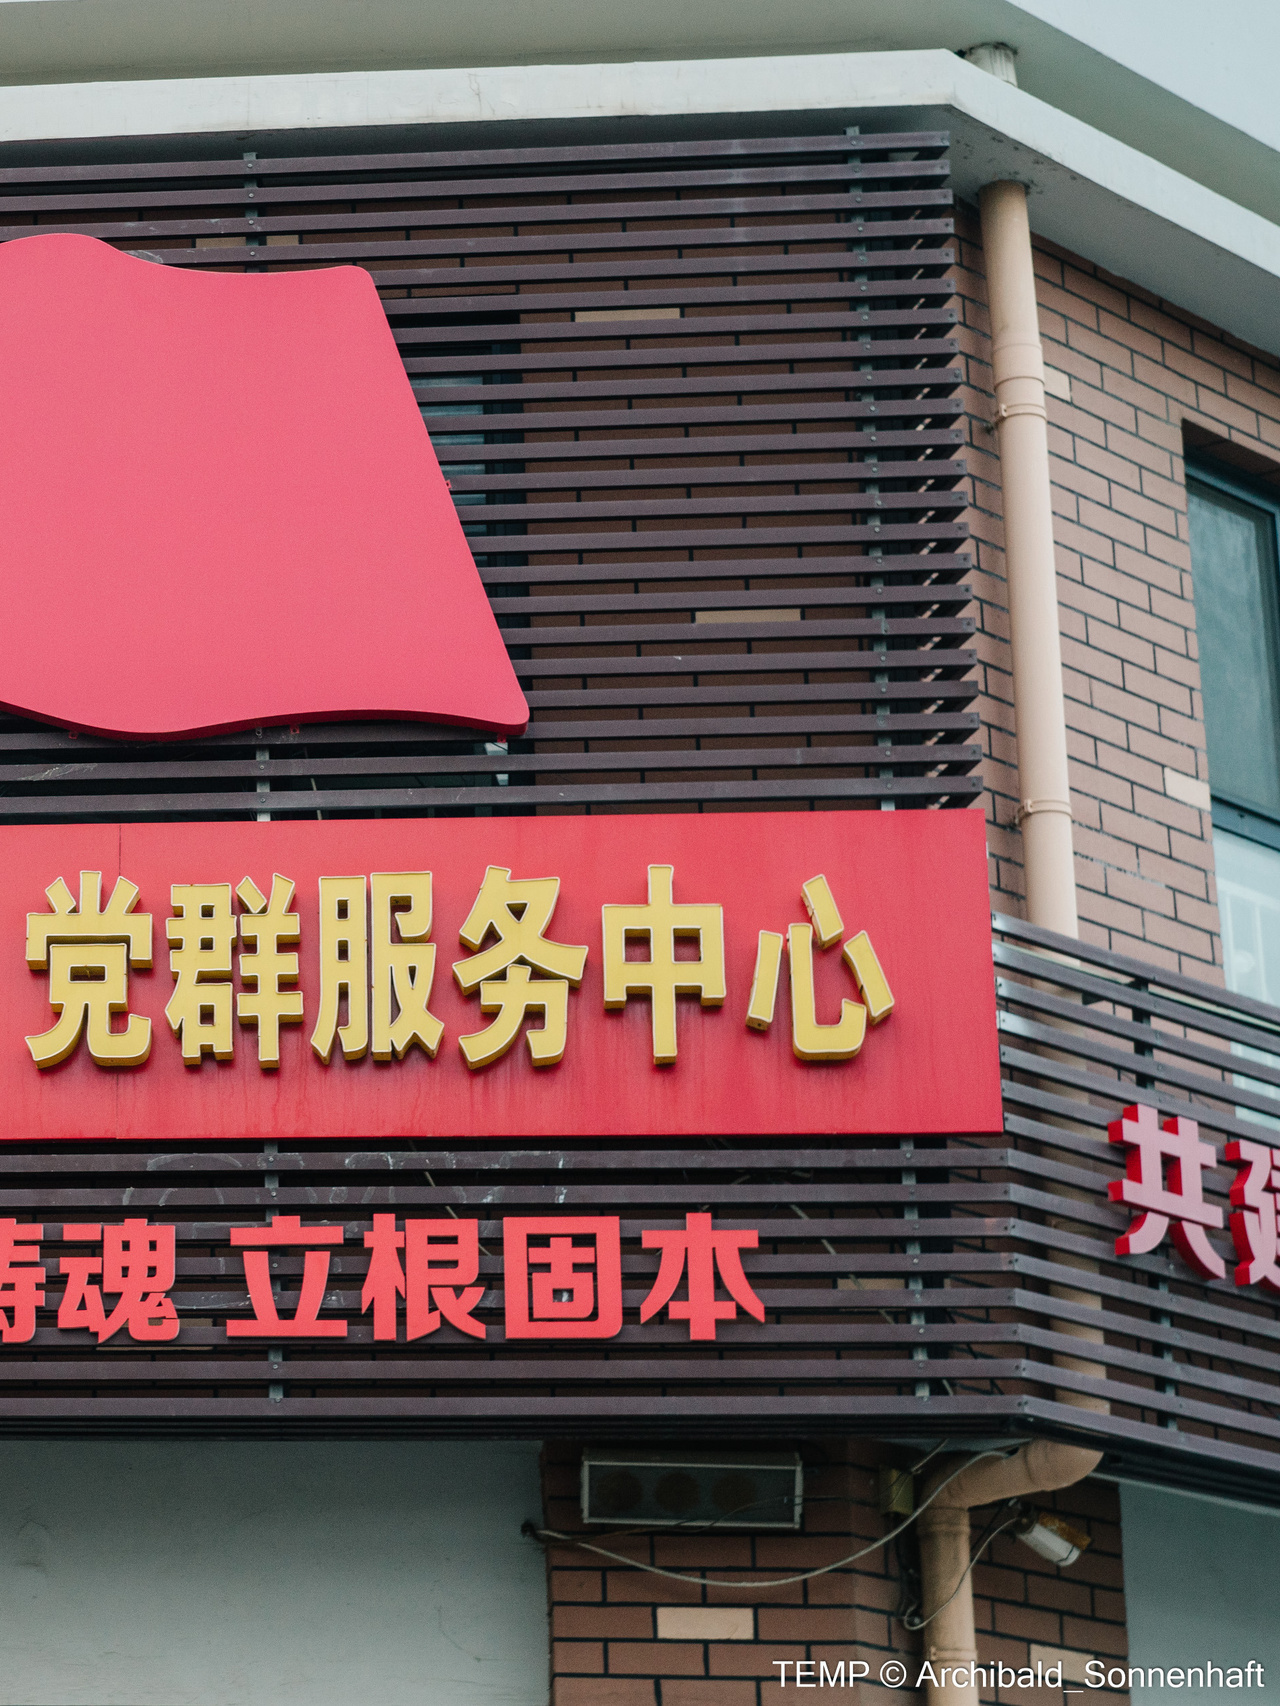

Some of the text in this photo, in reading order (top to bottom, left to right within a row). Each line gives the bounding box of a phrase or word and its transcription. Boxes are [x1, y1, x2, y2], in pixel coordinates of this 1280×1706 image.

[25, 865, 895, 1068] 党群服务中心
[226, 1212, 766, 1343] 立根固本
